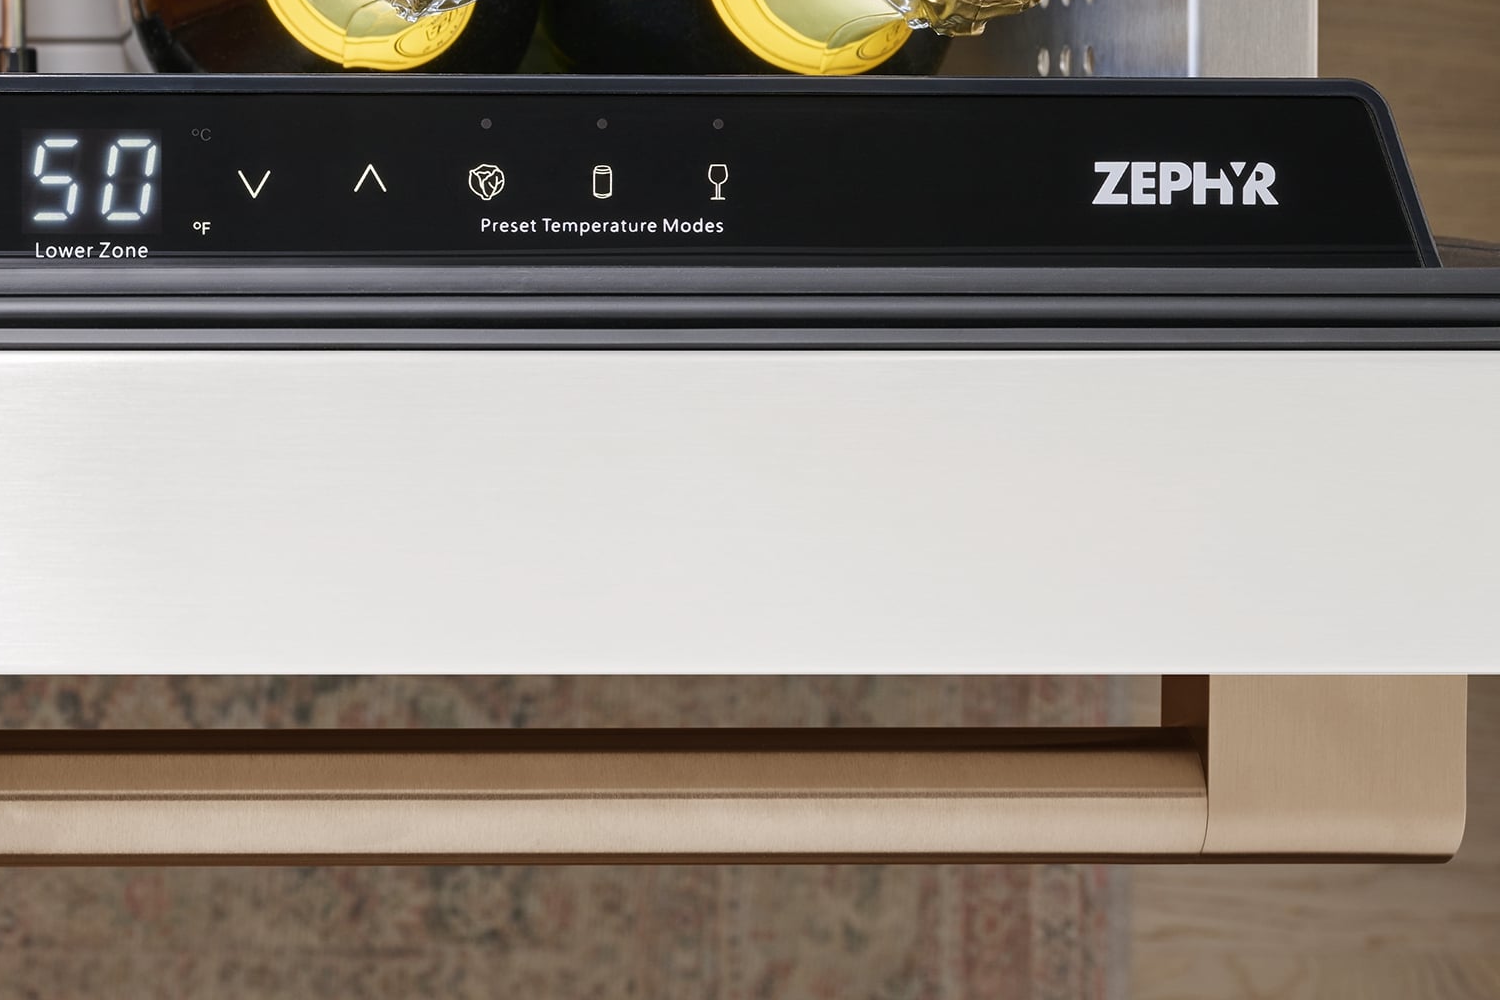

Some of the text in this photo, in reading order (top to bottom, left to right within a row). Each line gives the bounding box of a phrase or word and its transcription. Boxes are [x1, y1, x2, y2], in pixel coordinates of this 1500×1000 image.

[32, 137, 158, 222] 50
[1092, 161, 1279, 205] ZEPHYR
[480, 217, 725, 237] Preset Temperature Modes
[35, 242, 149, 259] Lower Zone
